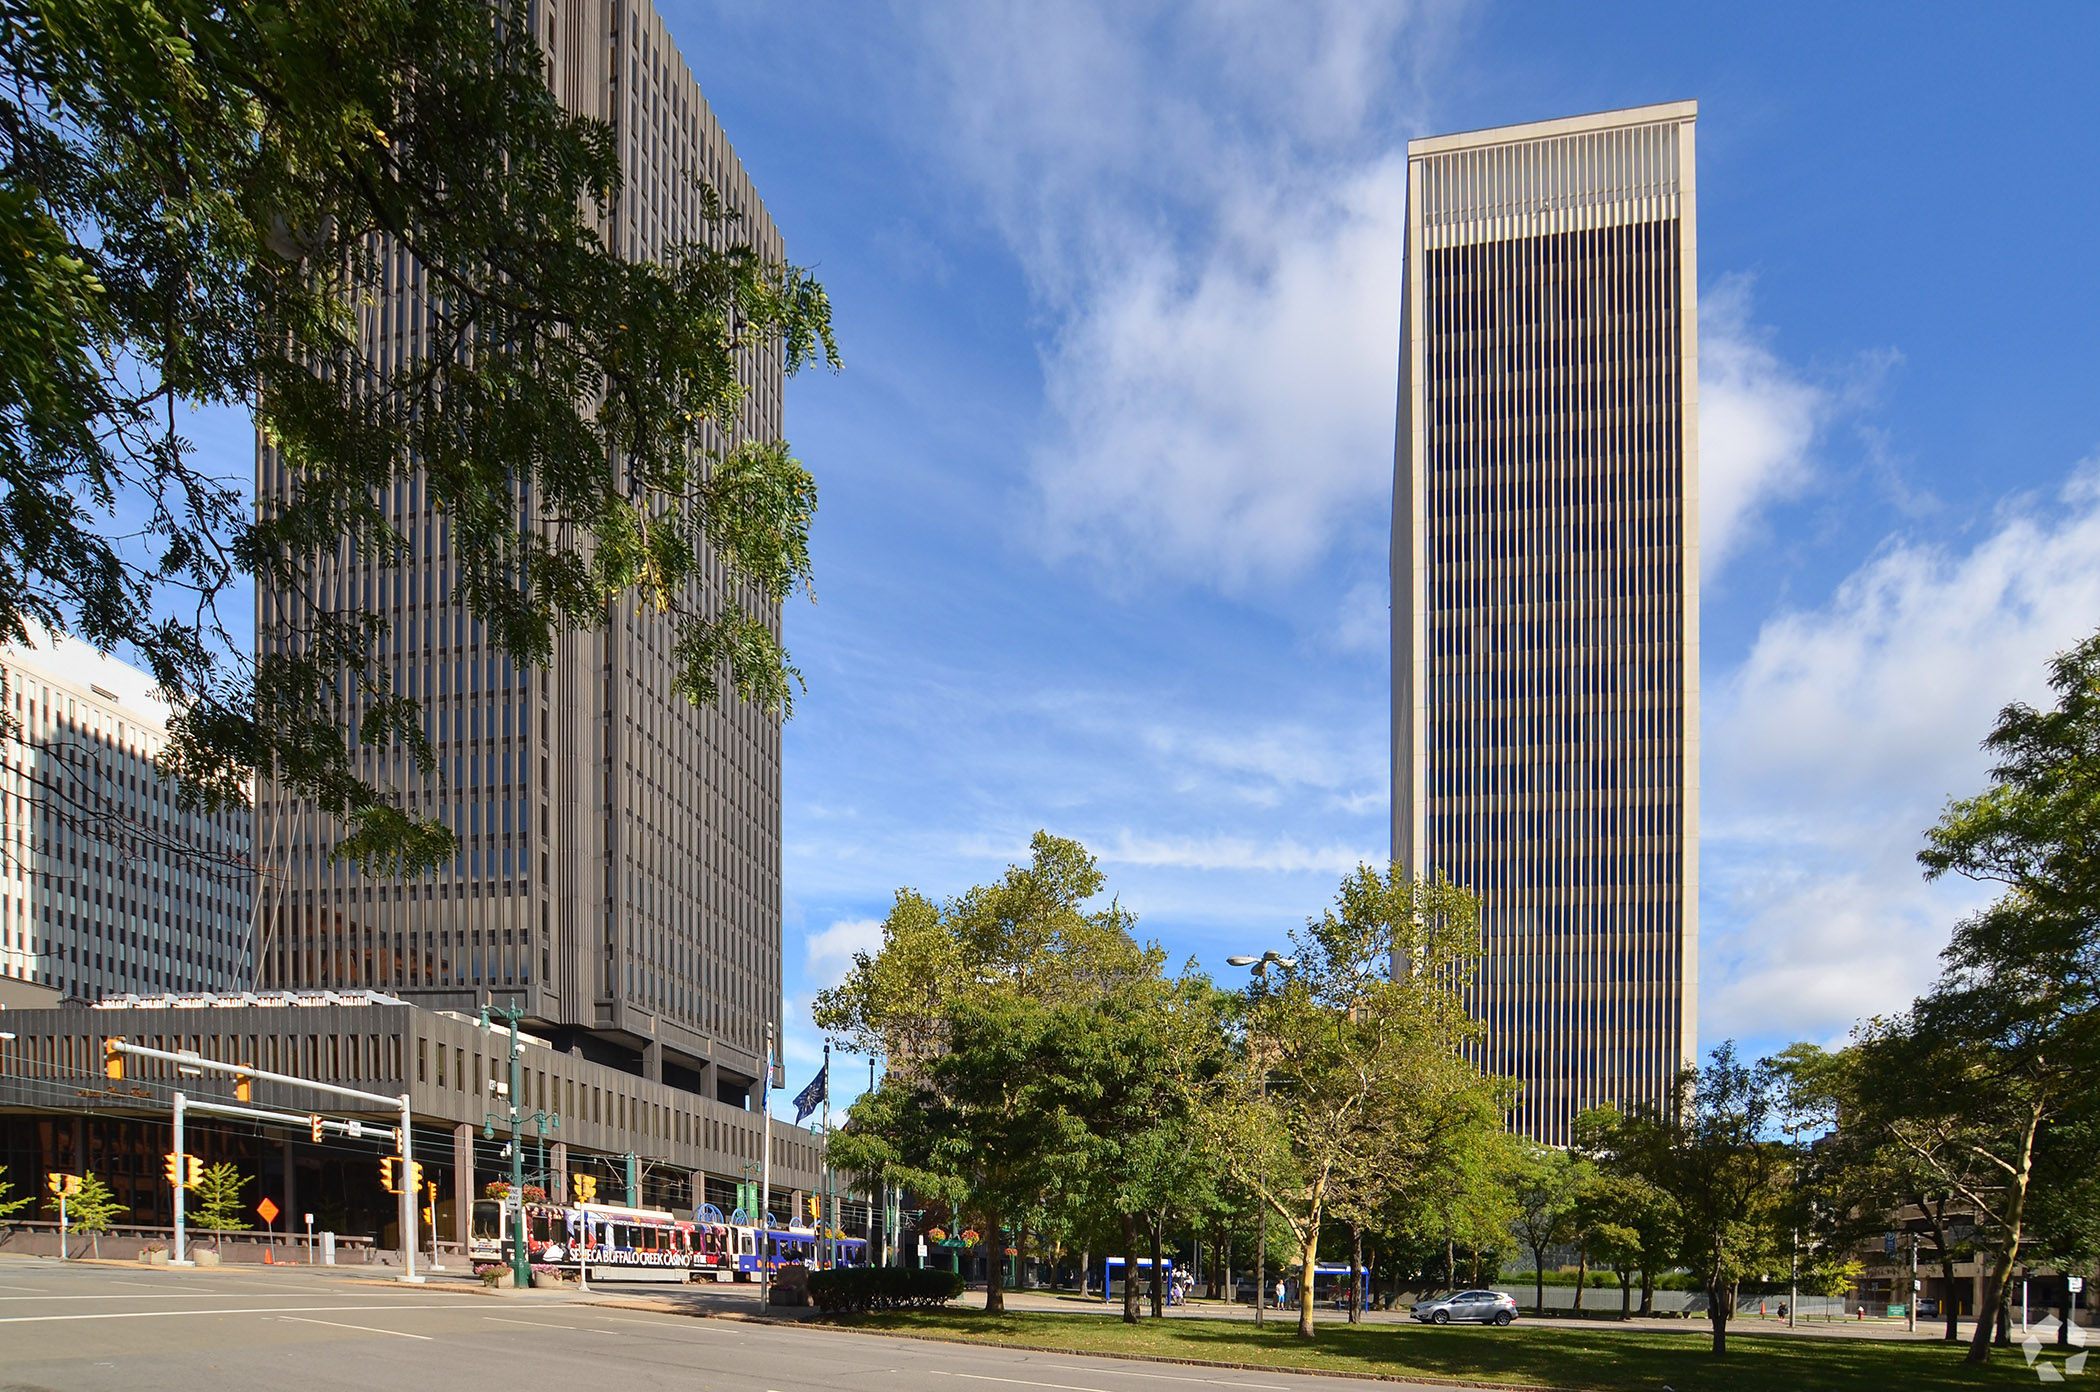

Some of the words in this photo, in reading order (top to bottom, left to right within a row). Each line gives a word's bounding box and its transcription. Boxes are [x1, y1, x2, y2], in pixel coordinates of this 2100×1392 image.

[602, 1249, 640, 1265] BUFFALO
[640, 1251, 664, 1266] CREEK
[663, 1252, 690, 1267] CASINO
